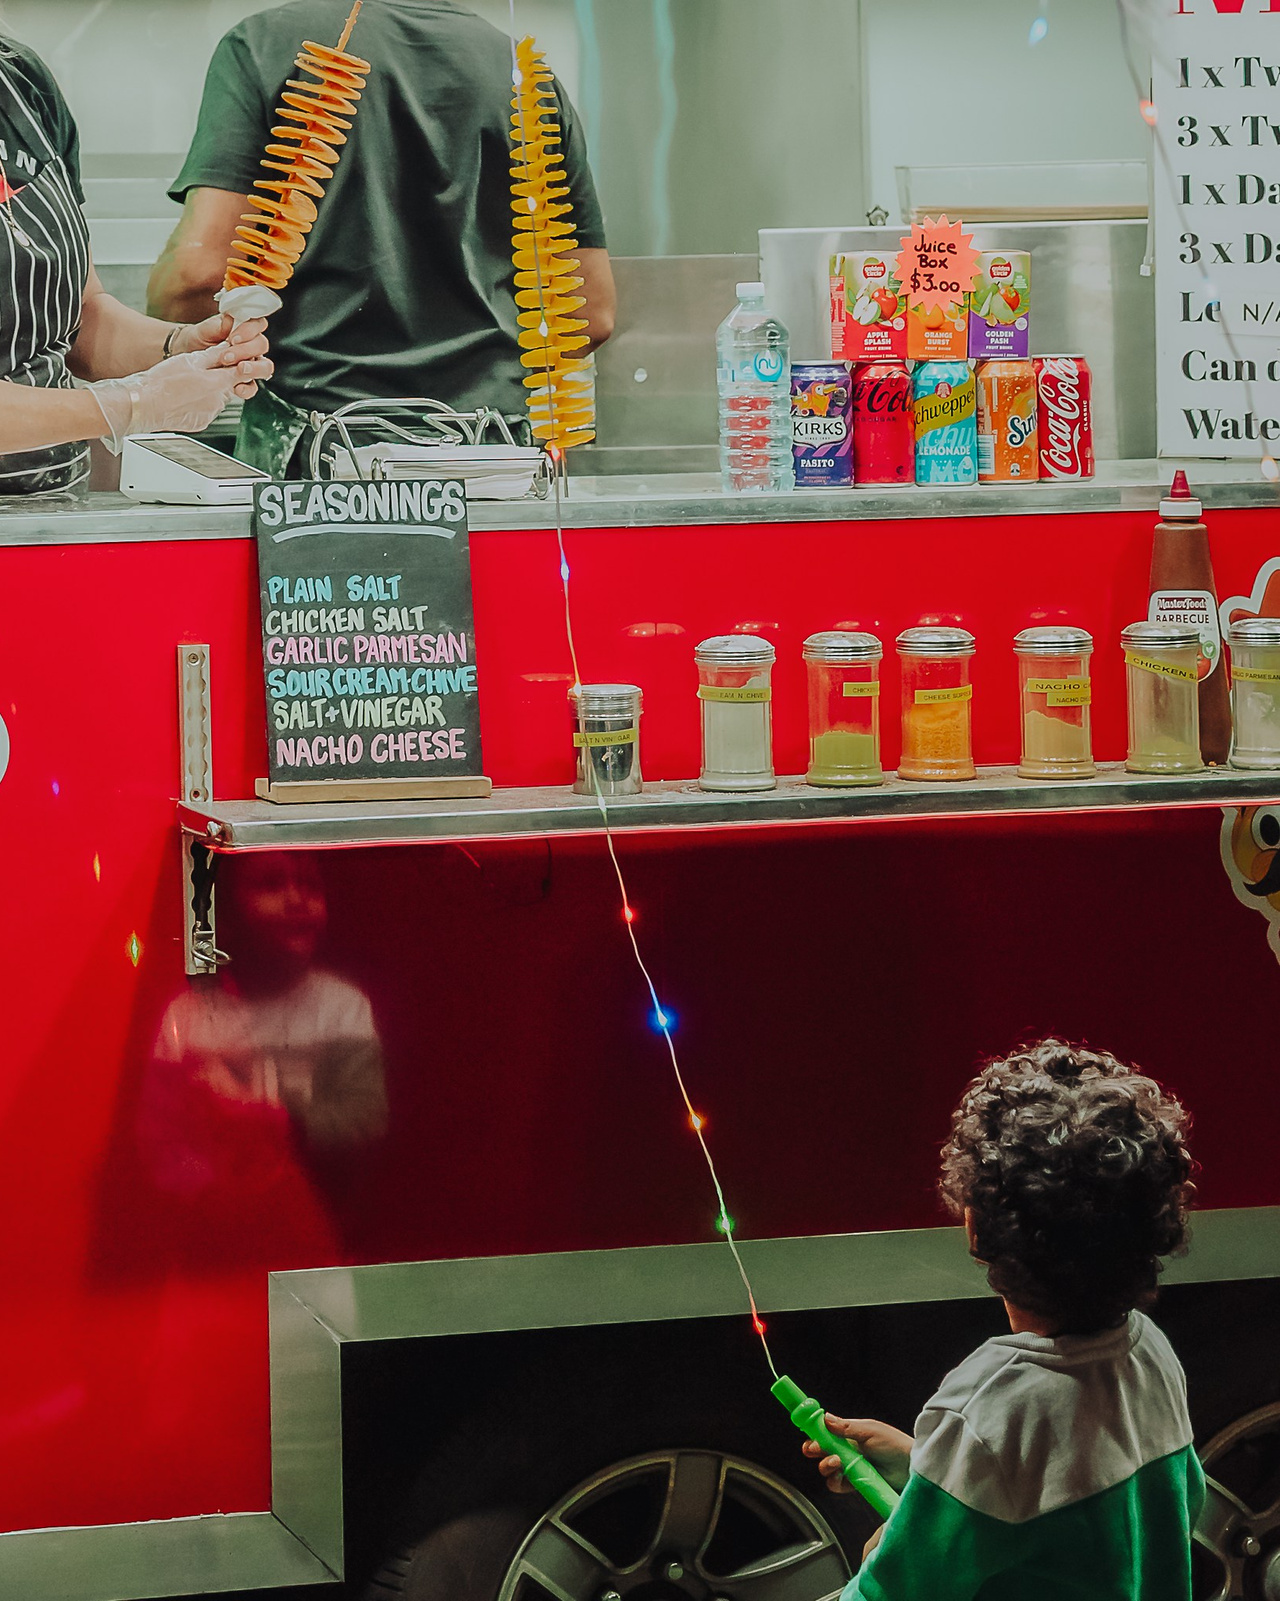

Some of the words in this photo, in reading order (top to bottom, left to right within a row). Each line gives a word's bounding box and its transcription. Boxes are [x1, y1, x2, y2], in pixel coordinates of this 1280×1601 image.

[1201, 66, 1226, 88] x
[1177, 116, 1199, 147] 3
[1208, 125, 1233, 147] x
[1177, 174, 1194, 205] 1
[1203, 184, 1228, 205] x
[914, 234, 957, 254] Juice
[1179, 232, 1201, 264] 3
[1210, 242, 1235, 264] x
[1243, 233, 1280, 264] D
[917, 254, 948, 269] Box
[910, 268, 960, 293] $3.00
[1243, 301, 1280, 326] N/
[1181, 349, 1258, 381] Can
[793, 421, 843, 436] KIRKS
[1181, 408, 1280, 440] Wate
[800, 459, 835, 468] PASITO
[919, 446, 971, 456] LEMONADE
[259, 481, 466, 526] SEASONINGS
[267, 575, 332, 604] PLAIN
[346, 574, 402, 602] SALT
[265, 607, 364, 636] CHICKEN
[372, 605, 428, 633] SALT
[1156, 614, 1210, 624] BARBECUE
[267, 635, 348, 665] GARLIC
[354, 632, 467, 664] PARMESAN
[1133, 657, 1187, 678] CHICKEN
[924, 693, 951, 701] CHEESE
[276, 734, 363, 768] NACHO
[371, 728, 467, 763] CHEESE
[602, 734, 630, 743] VINGAR
